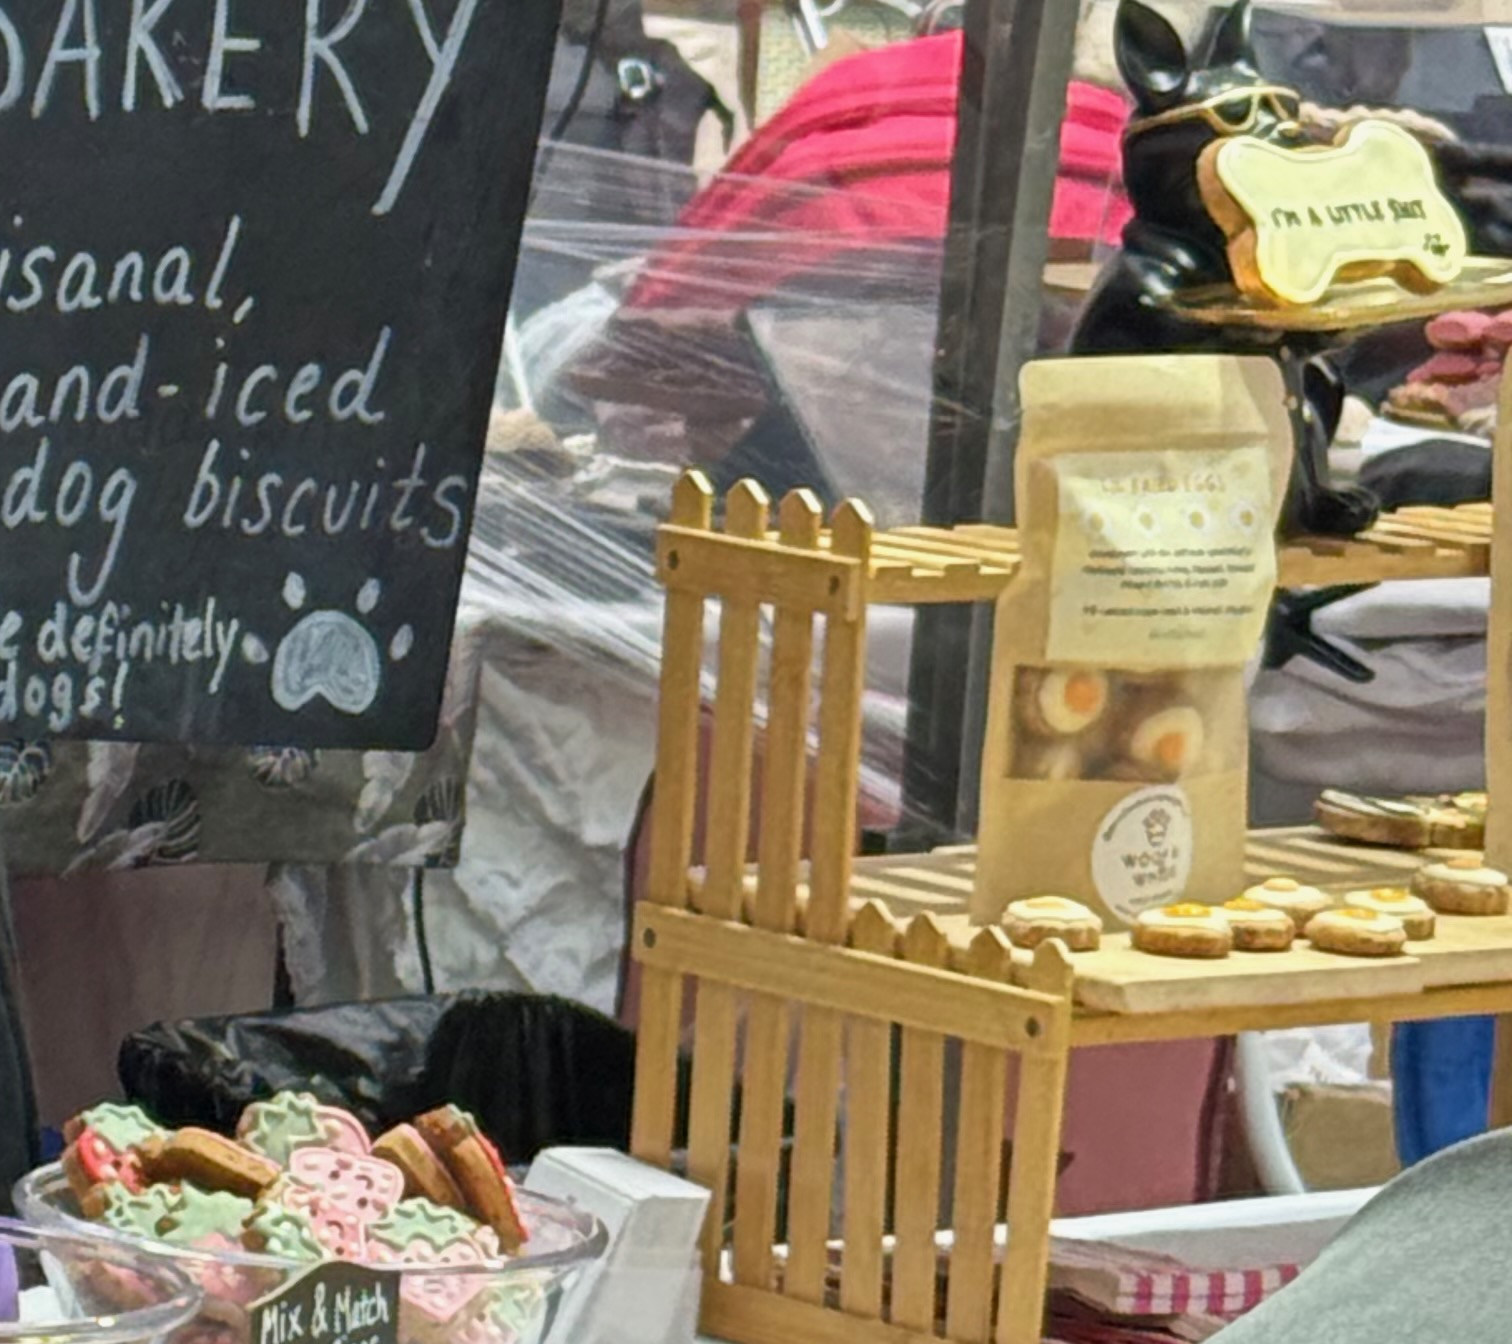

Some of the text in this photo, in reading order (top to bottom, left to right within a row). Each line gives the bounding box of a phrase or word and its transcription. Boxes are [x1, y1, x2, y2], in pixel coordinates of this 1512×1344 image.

[0, 438, 468, 606] dog biscuits
[311, 1281, 329, 1339] &
[333, 1281, 390, 1335] Match
